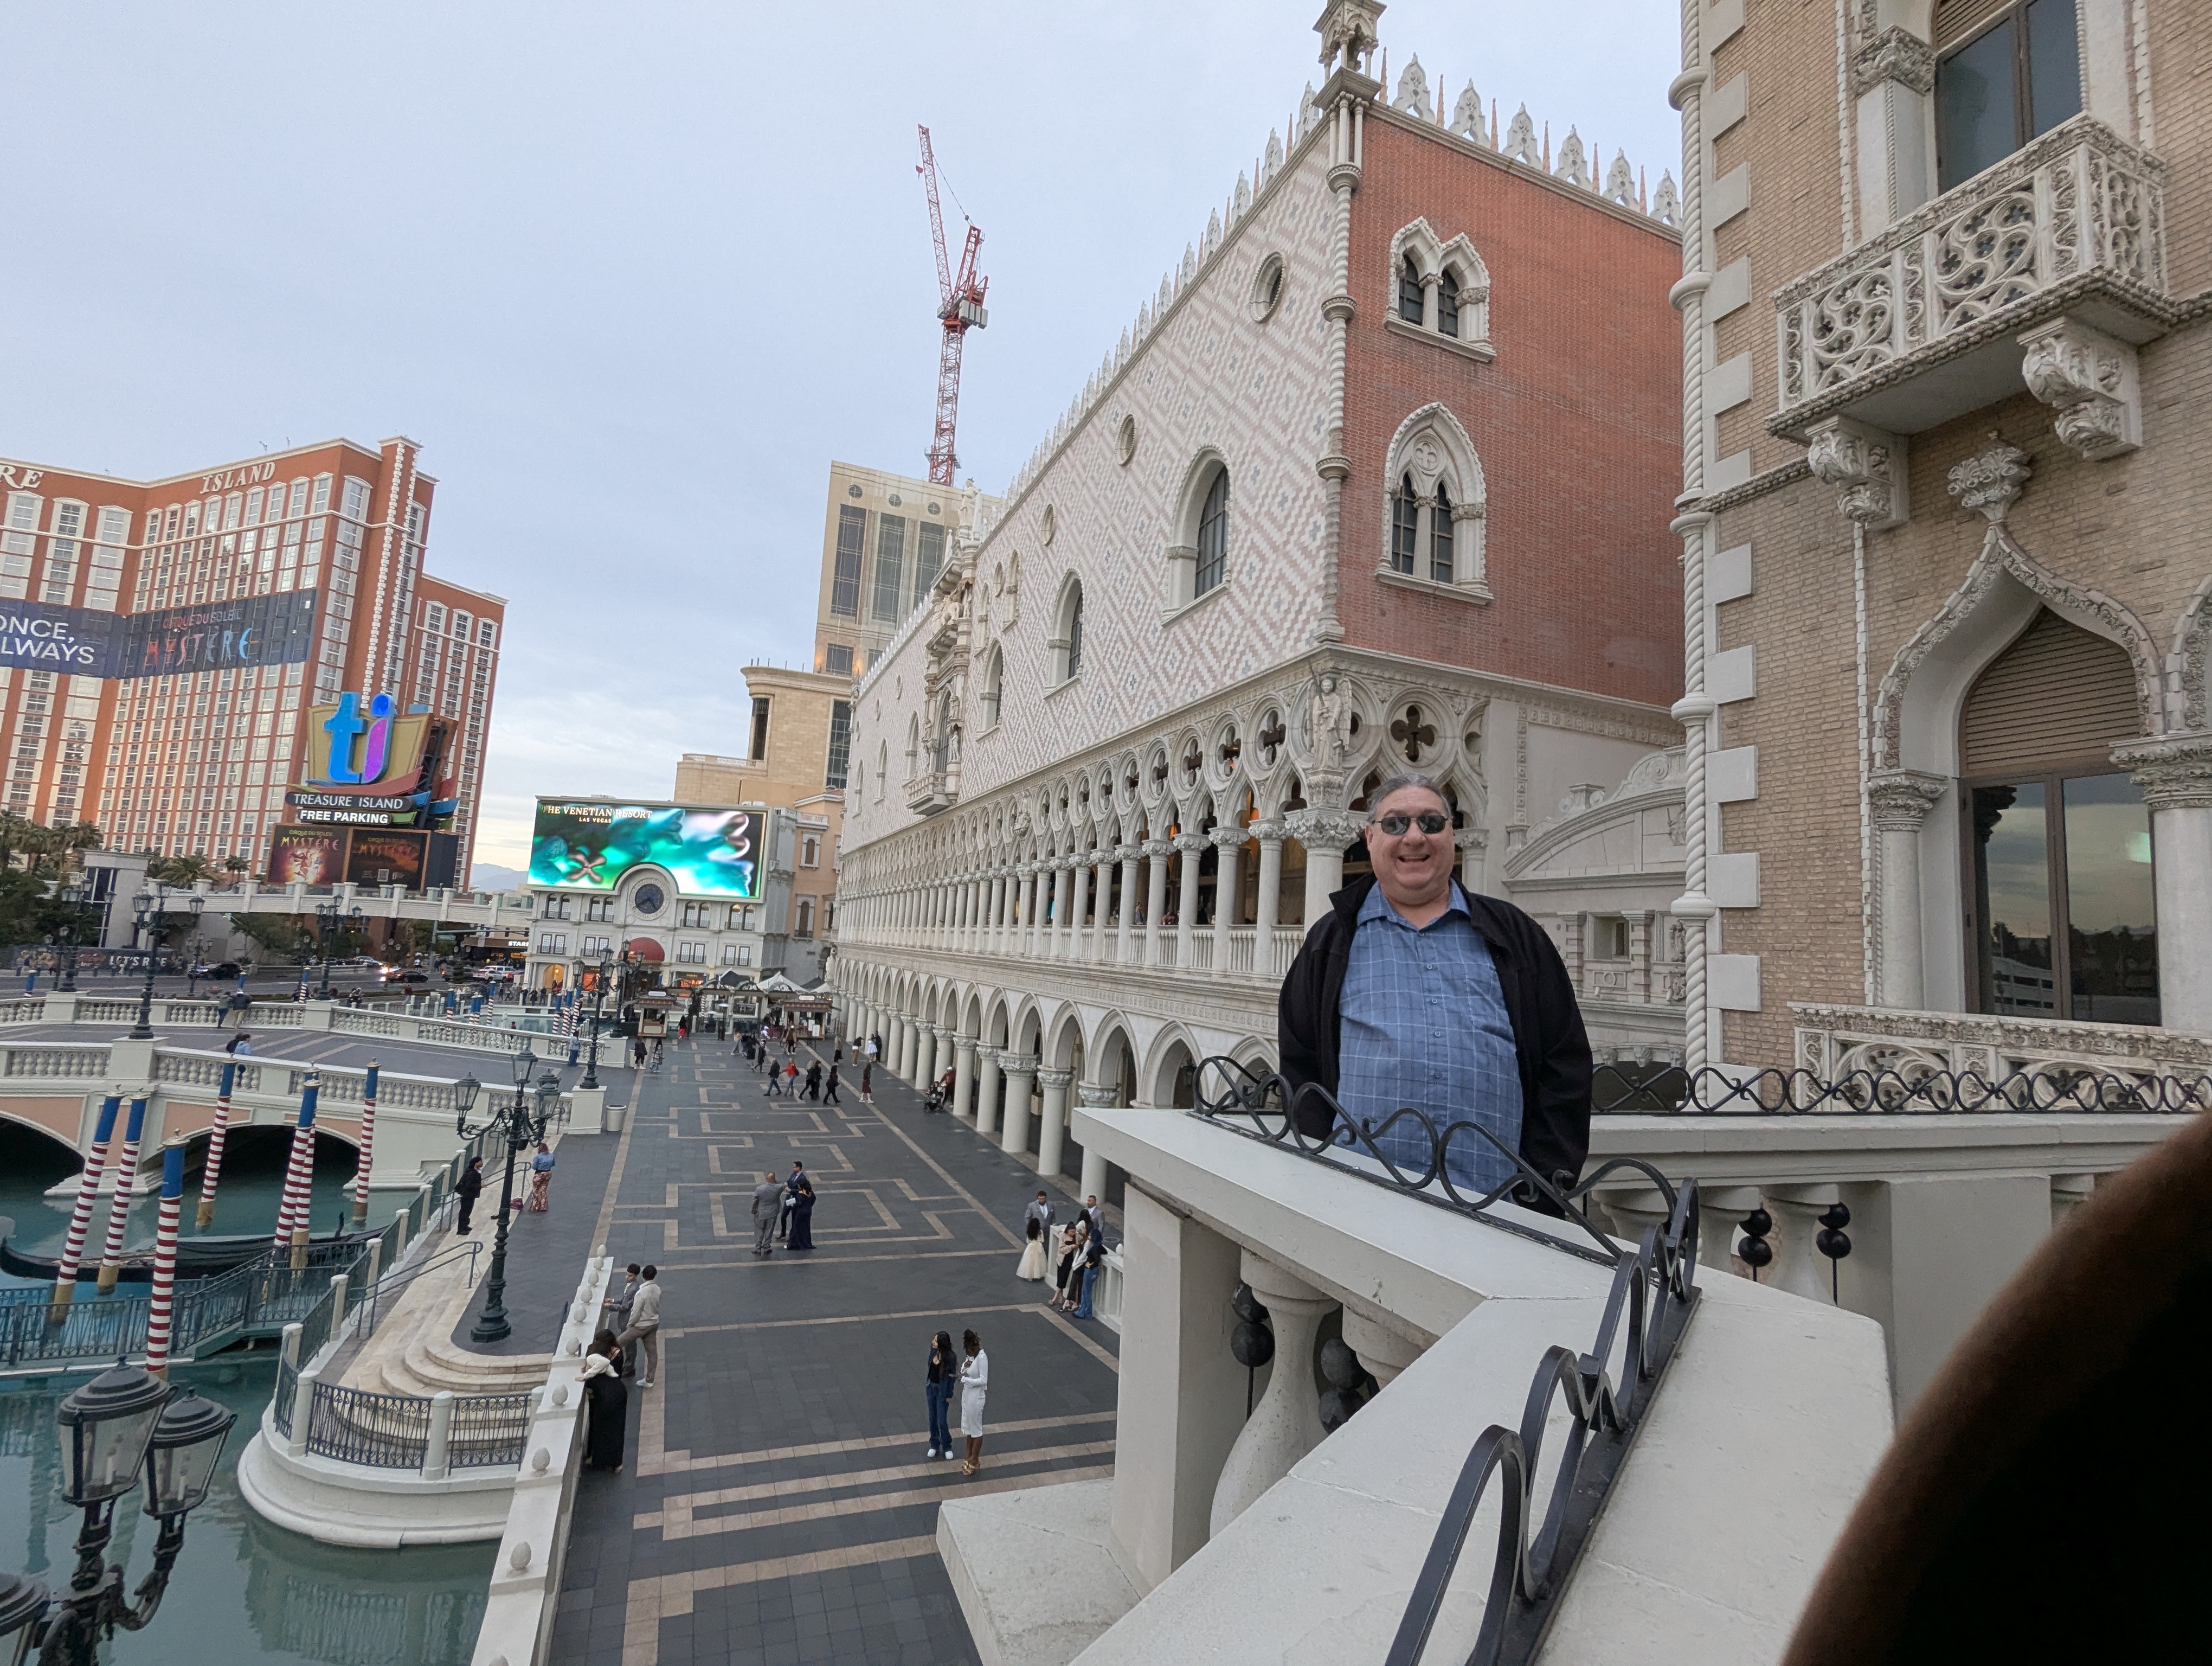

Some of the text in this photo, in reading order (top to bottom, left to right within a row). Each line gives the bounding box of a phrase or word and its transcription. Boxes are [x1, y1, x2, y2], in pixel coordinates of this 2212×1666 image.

[0, 465, 44, 489] RE
[200, 462, 275, 494] ISLAND
[196, 613, 209, 625] DU
[2, 637, 94, 664] LWAYS
[294, 794, 403, 809] TREASURE ISLAND
[300, 810, 389, 824] FREE PARKING
[542, 805, 653, 819] THE VENETIAN RESORT
[142, 957, 168, 967] RE
